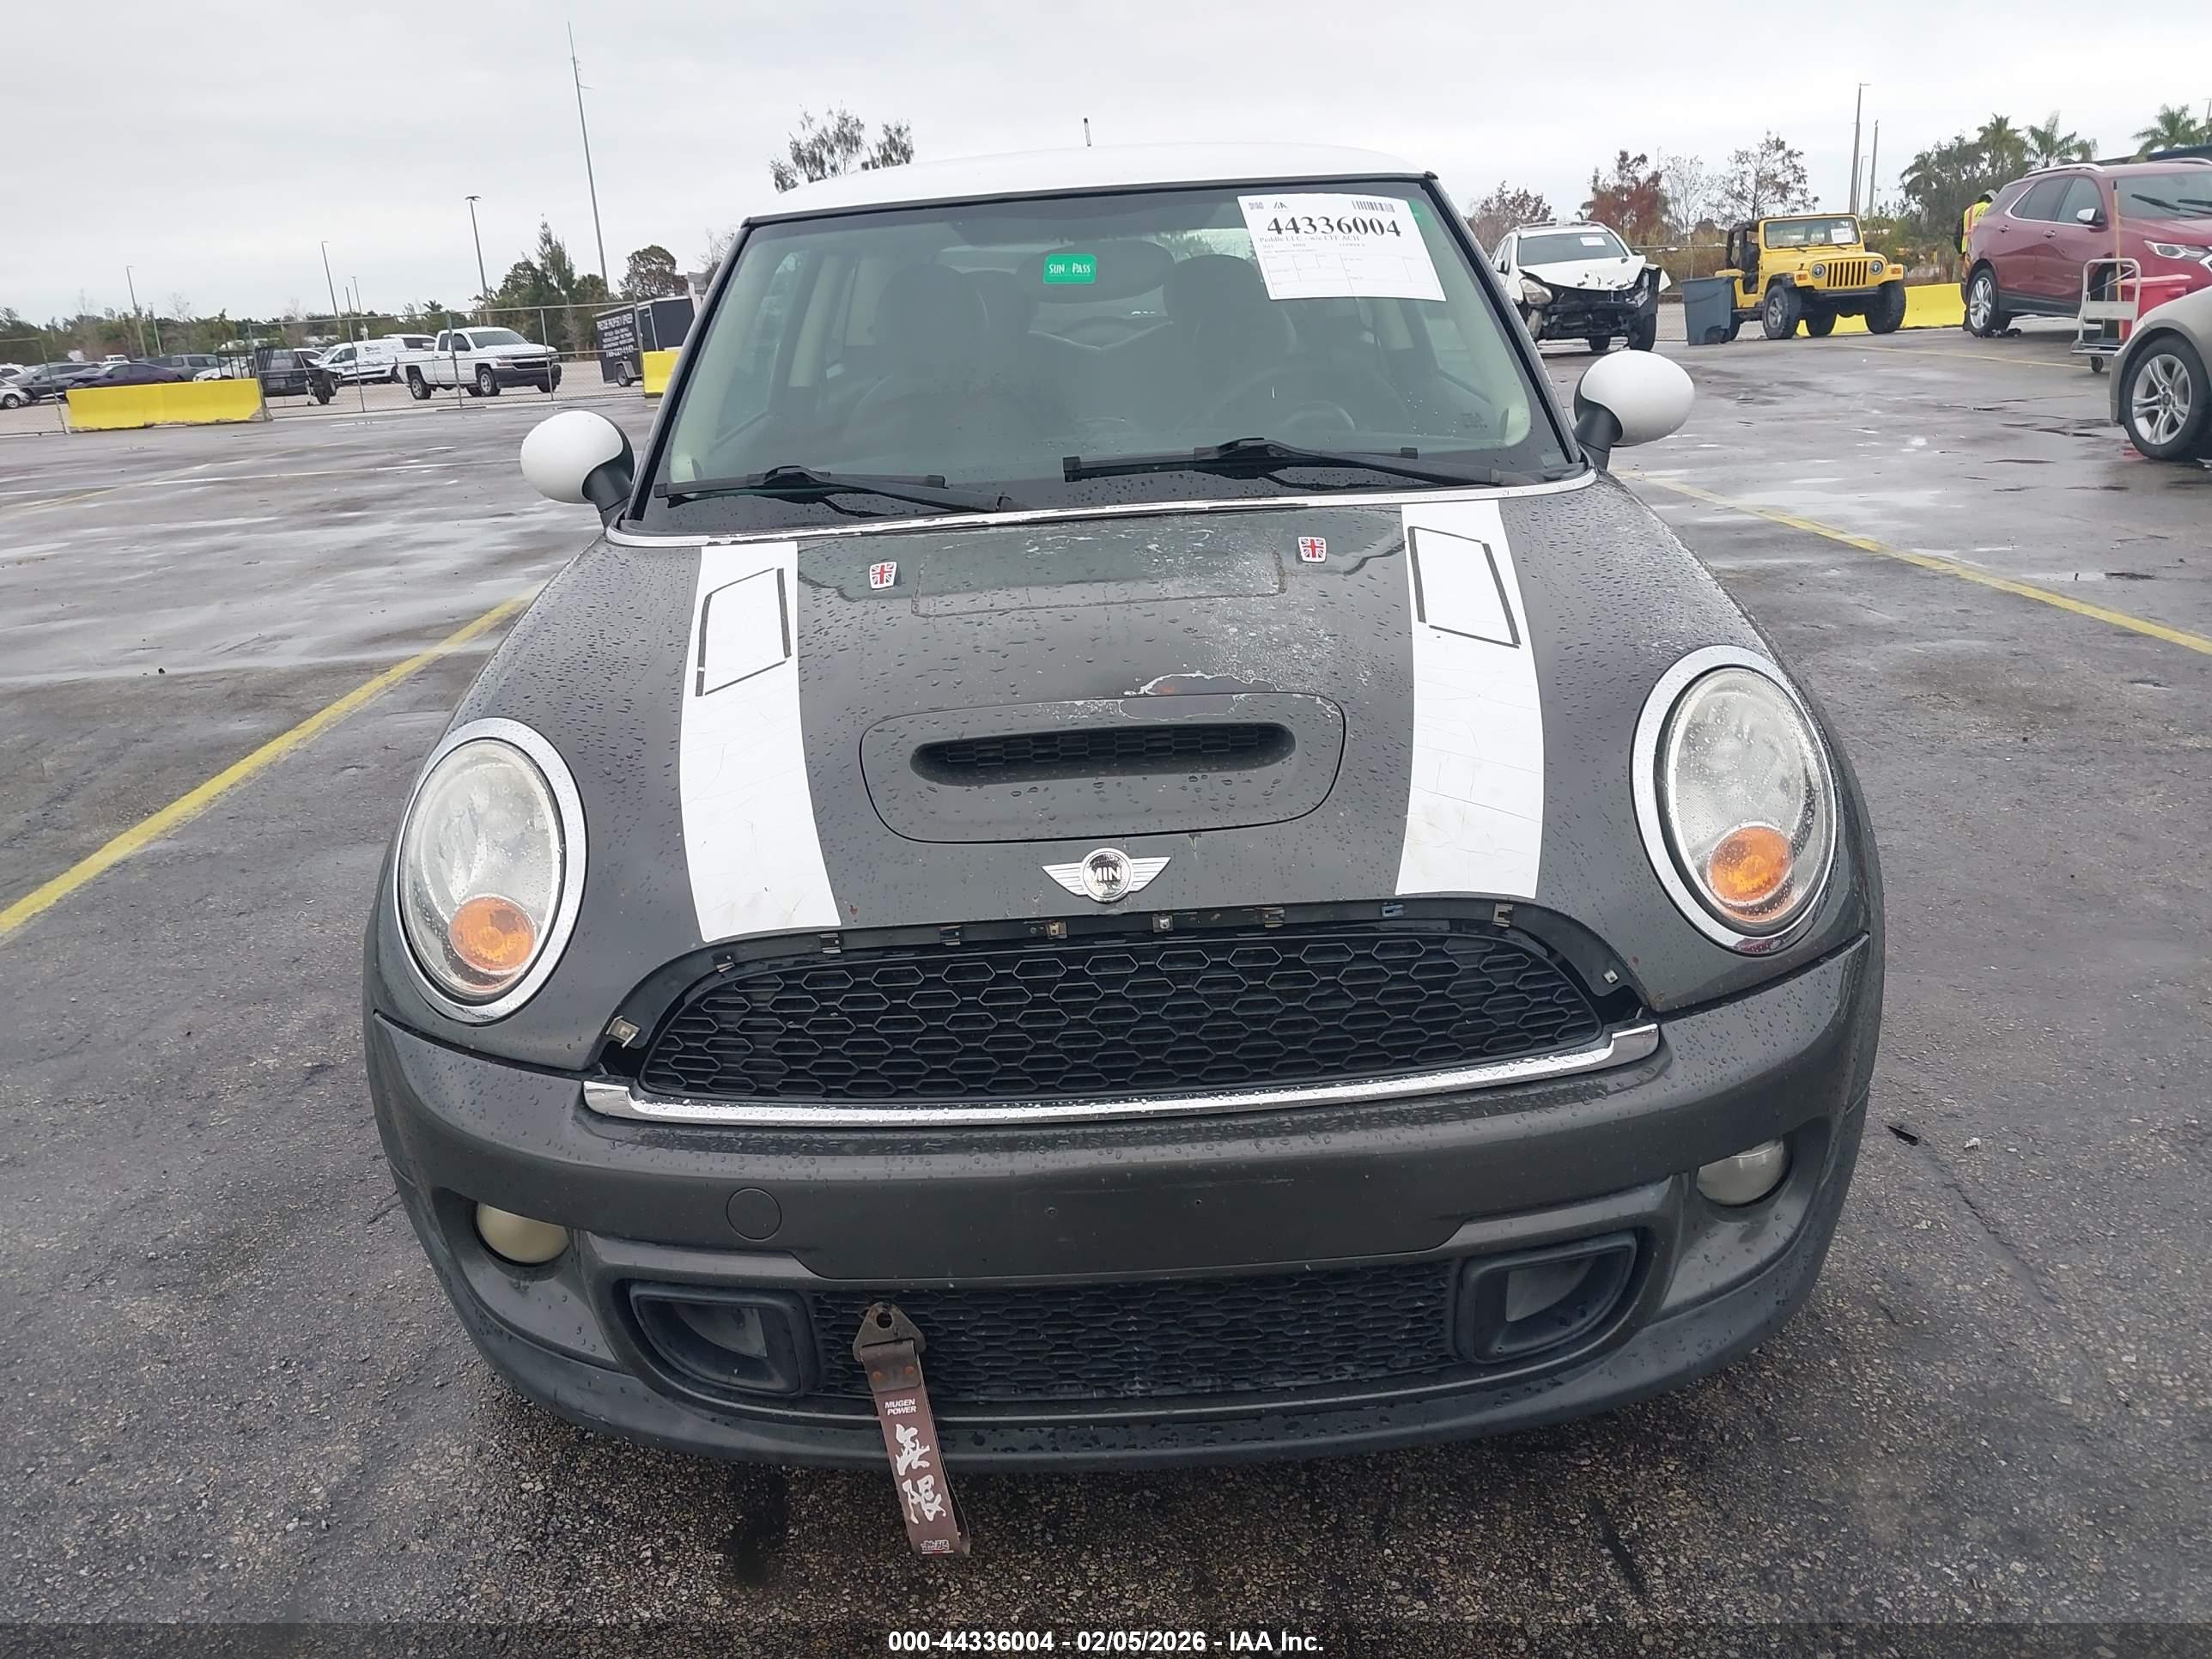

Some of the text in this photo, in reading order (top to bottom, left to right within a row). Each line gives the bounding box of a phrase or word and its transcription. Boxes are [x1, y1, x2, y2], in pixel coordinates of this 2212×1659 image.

[1267, 216, 1401, 237] 44336004
[1048, 262, 1091, 274] SUN PASS
[884, 1398, 915, 1409] MUGEN
[887, 1406, 917, 1416] POWER
